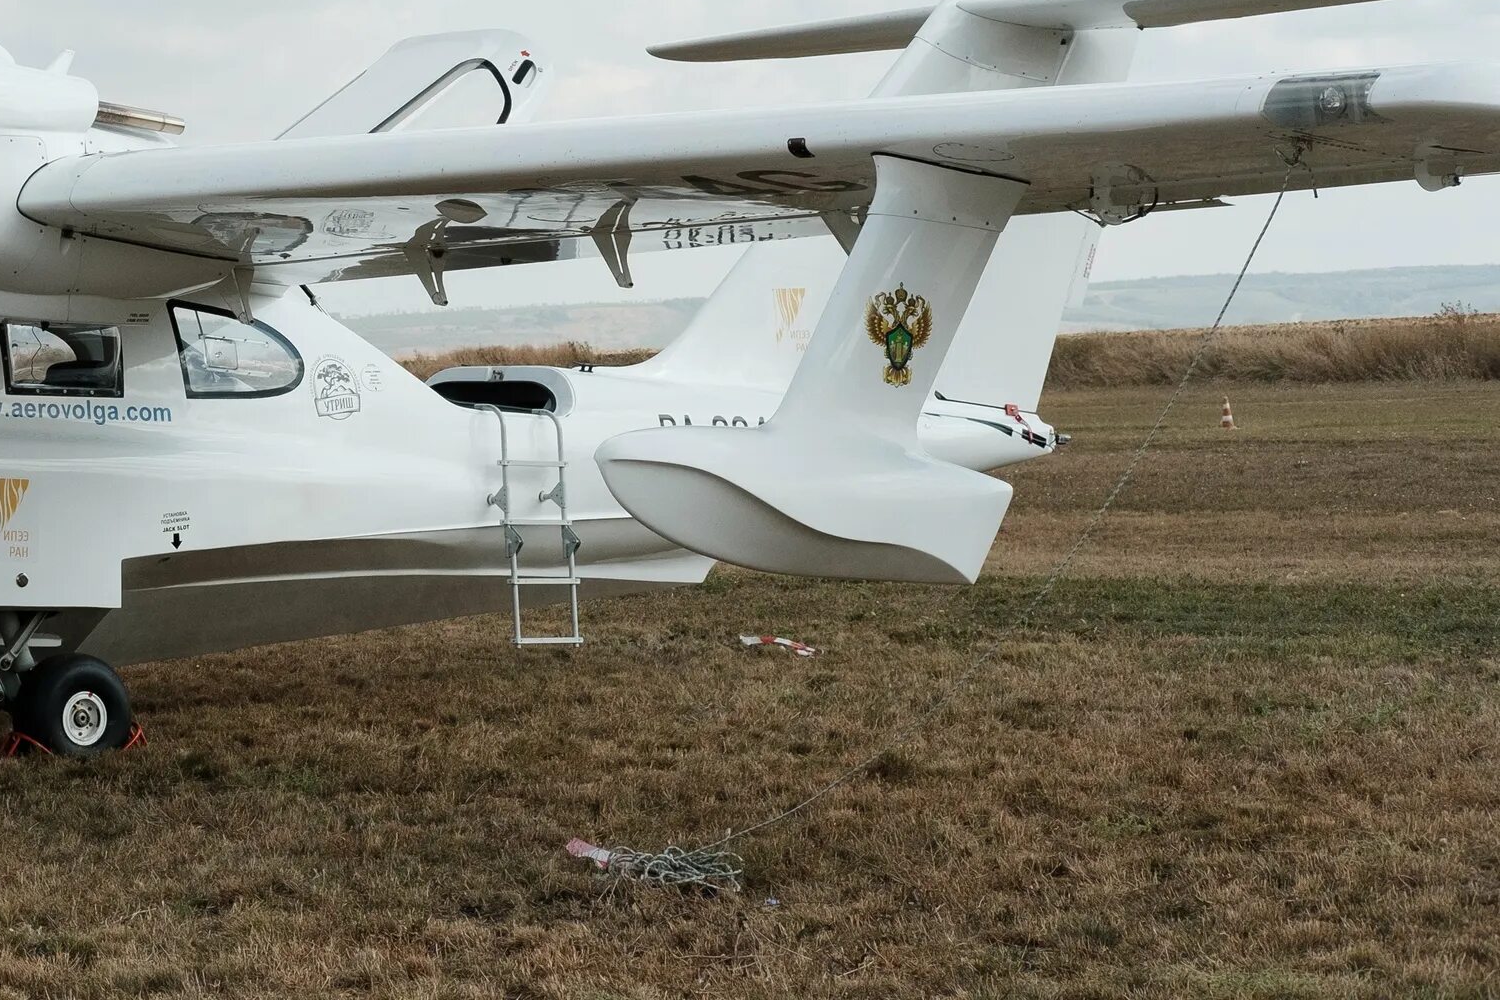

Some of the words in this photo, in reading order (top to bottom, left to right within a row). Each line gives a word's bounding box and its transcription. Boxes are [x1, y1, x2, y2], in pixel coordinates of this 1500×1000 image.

[324, 397, 354, 412] УТРИШ
[3, 530, 29, 542] ИПЭЭ
[9, 546, 29, 558] РАН
